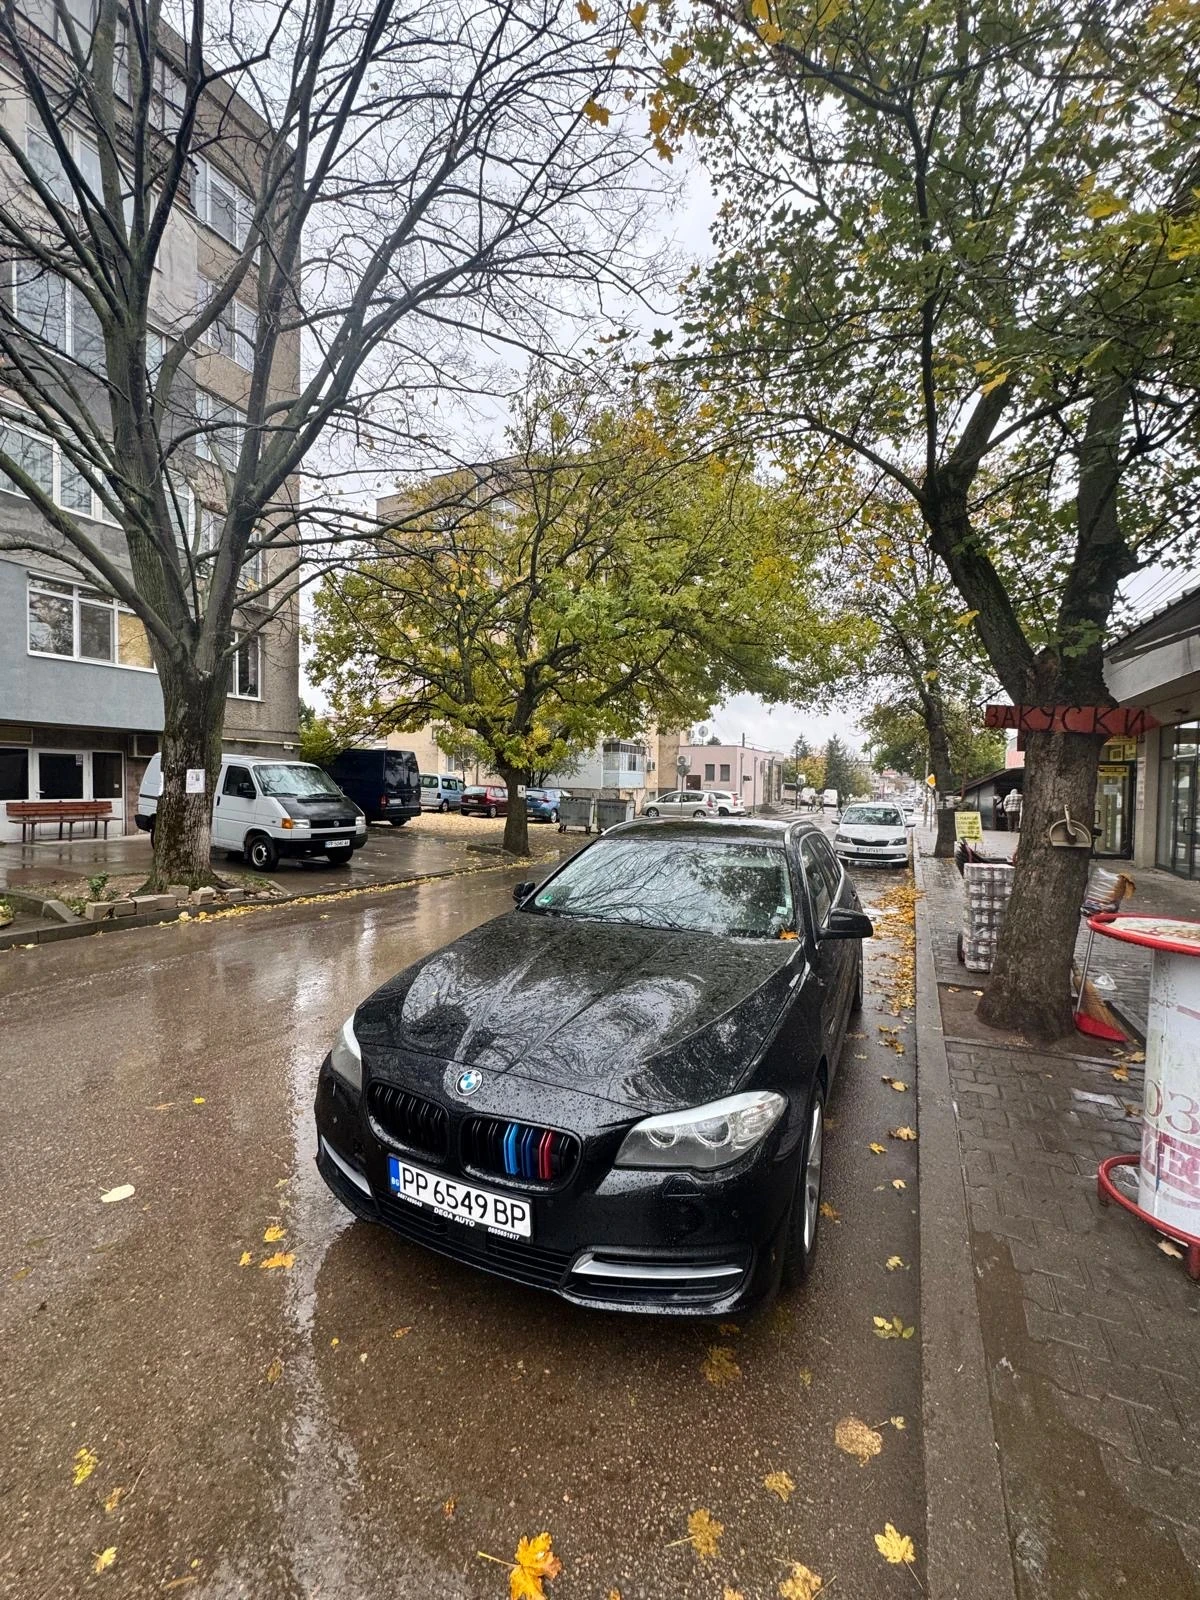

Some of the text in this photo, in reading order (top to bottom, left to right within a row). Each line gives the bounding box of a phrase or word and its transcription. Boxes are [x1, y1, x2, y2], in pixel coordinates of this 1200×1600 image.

[986, 706, 1146, 736] ЗАКУСКИ
[402, 1166, 428, 1196] PP
[434, 1181, 487, 1218] 6549
[494, 1199, 526, 1228] BP
[433, 1207, 475, 1228] DEGA AUTO
